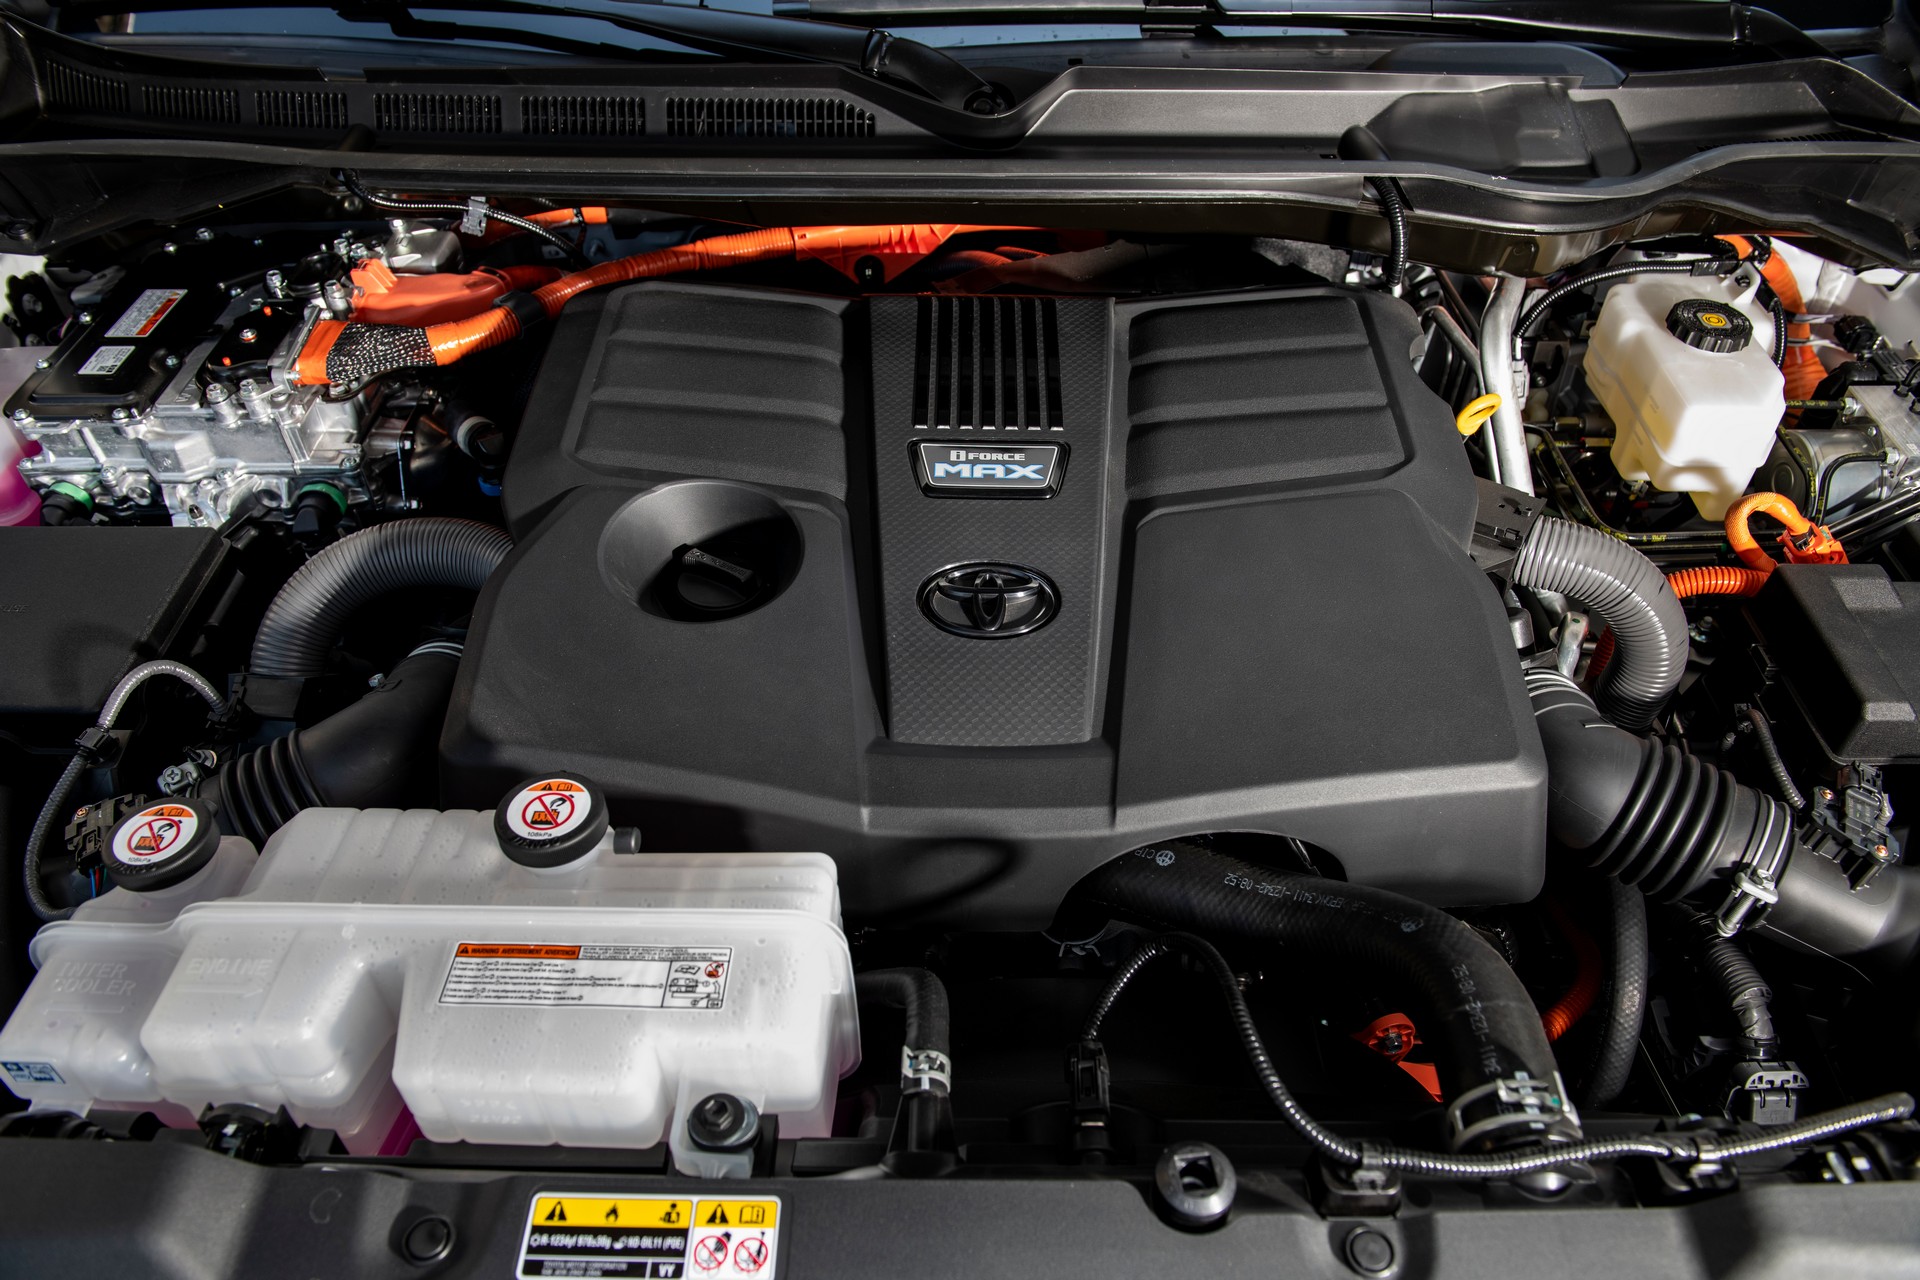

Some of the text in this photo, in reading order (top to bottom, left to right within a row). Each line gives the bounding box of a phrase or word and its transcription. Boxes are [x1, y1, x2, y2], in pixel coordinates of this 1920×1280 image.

[968, 452, 1025, 461] FORCE
[934, 462, 1044, 479] MAX
[57, 961, 128, 978] INTER
[185, 957, 273, 977] ENGINE
[51, 978, 137, 996] COOLER
